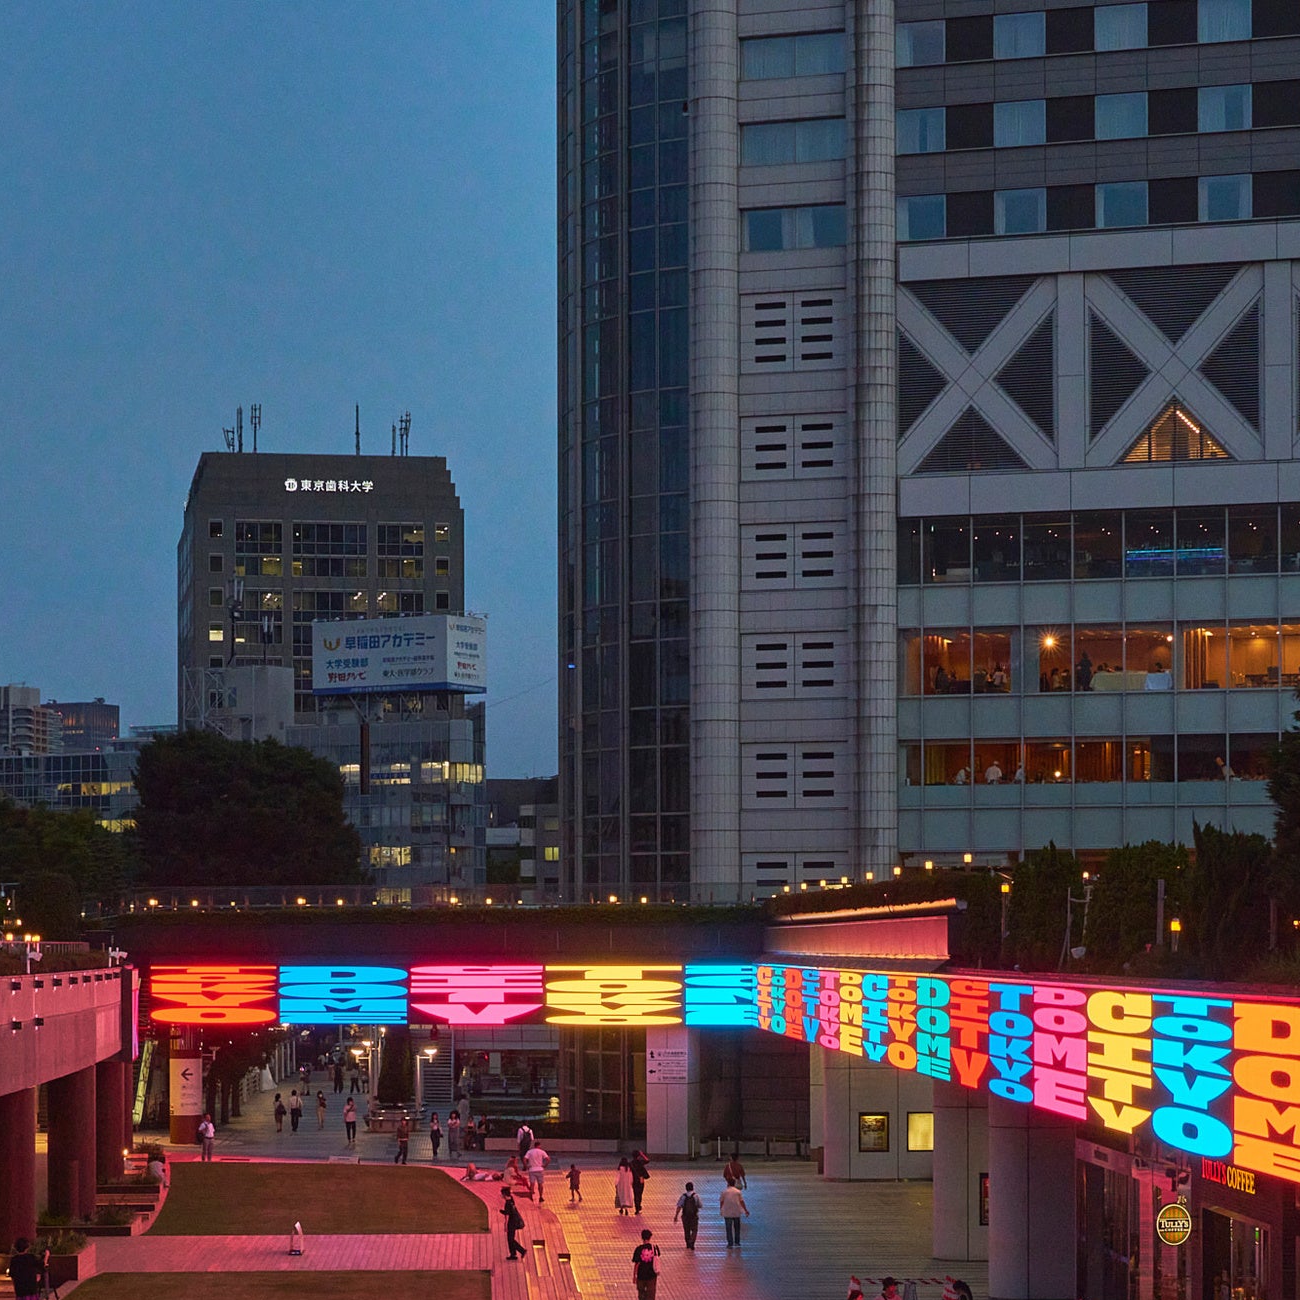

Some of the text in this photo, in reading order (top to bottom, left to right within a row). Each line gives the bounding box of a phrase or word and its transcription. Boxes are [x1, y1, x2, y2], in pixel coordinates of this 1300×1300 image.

[301, 480, 373, 492] 東京歯科大学
[345, 633, 435, 650] 早稲田アカデミー
[785, 968, 803, 1040] DOME
[802, 970, 820, 1043] CITY
[819, 972, 839, 1049] TOKYO
[840, 972, 863, 1056] DOME
[862, 974, 888, 1062] CITY
[887, 976, 917, 1069] TOKYO
[916, 977, 951, 1081] DOME
[950, 979, 989, 1088] CITY
[988, 983, 1034, 1103] TOKYO
[1033, 986, 1087, 1120] DOME
[1087, 991, 1151, 1134] CITY
[1152, 995, 1232, 1157] TOKYO
[1160, 1219, 1189, 1228] TULLY'S
[1227, 1166, 1256, 1195] COFFEE
